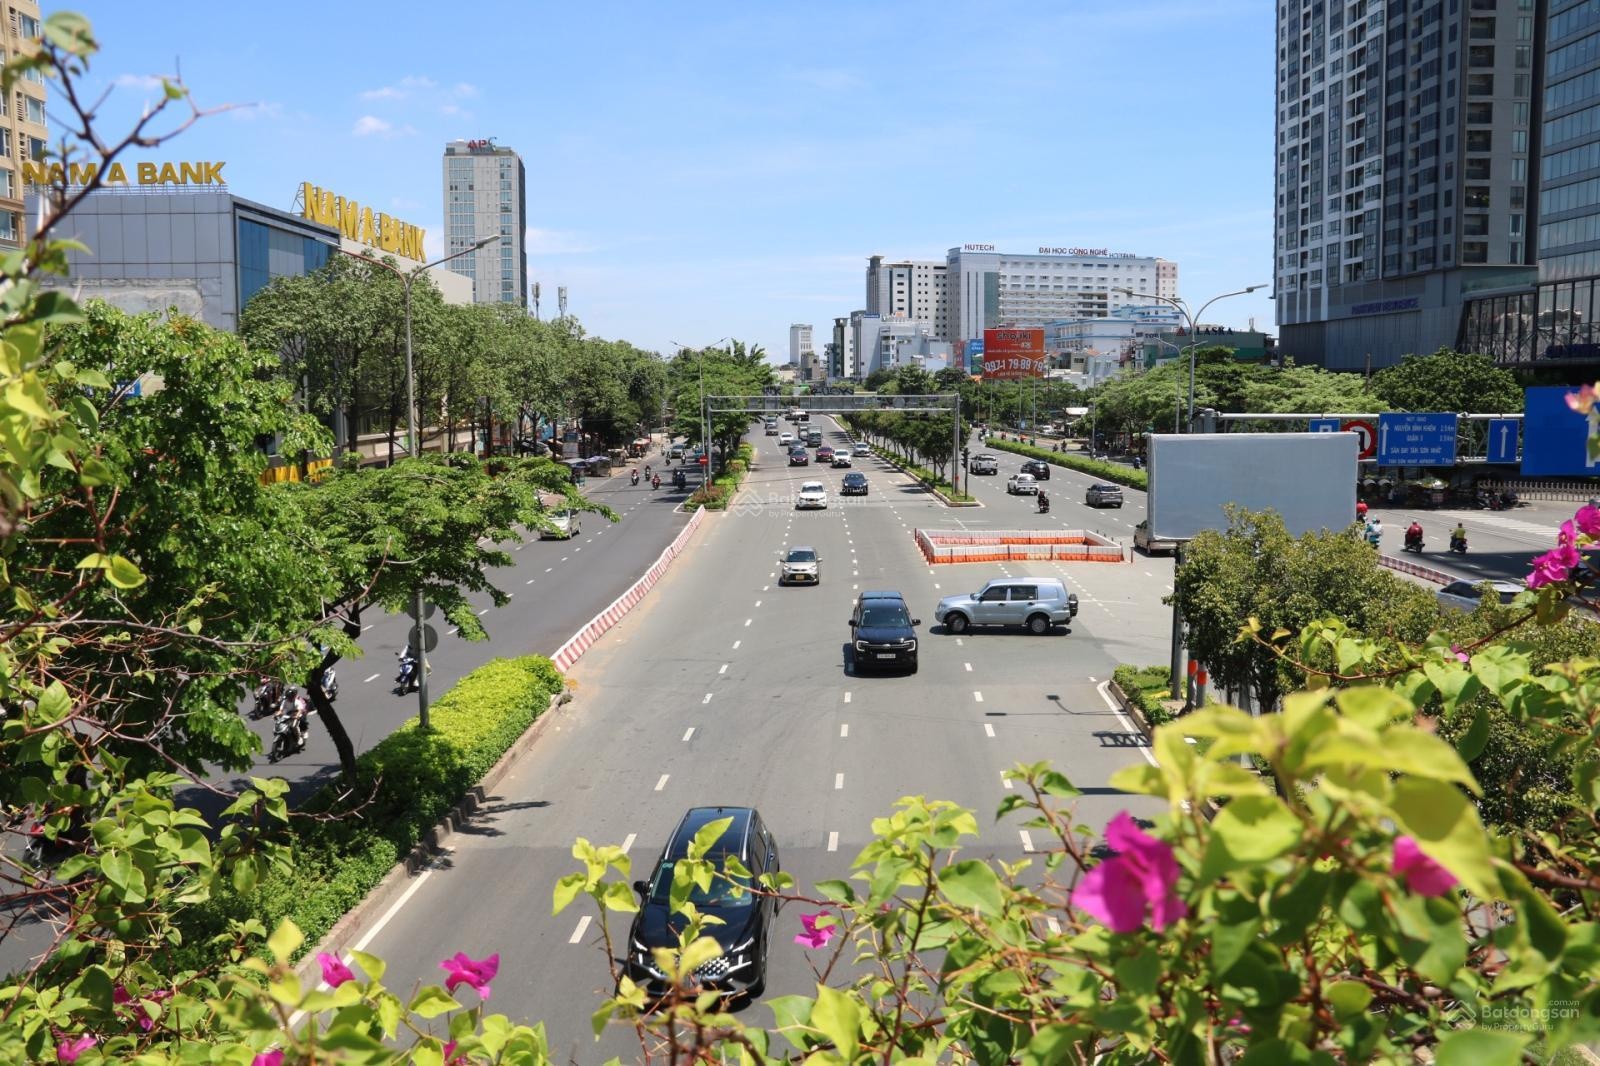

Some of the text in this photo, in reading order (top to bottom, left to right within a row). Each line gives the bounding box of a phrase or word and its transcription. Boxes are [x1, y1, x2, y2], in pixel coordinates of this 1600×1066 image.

[23, 162, 226, 185] NAM A BANK
[304, 181, 427, 264] NAM A BANK
[1068, 247, 1088, 256] CÔNG
[1008, 358, 1019, 370] 79
